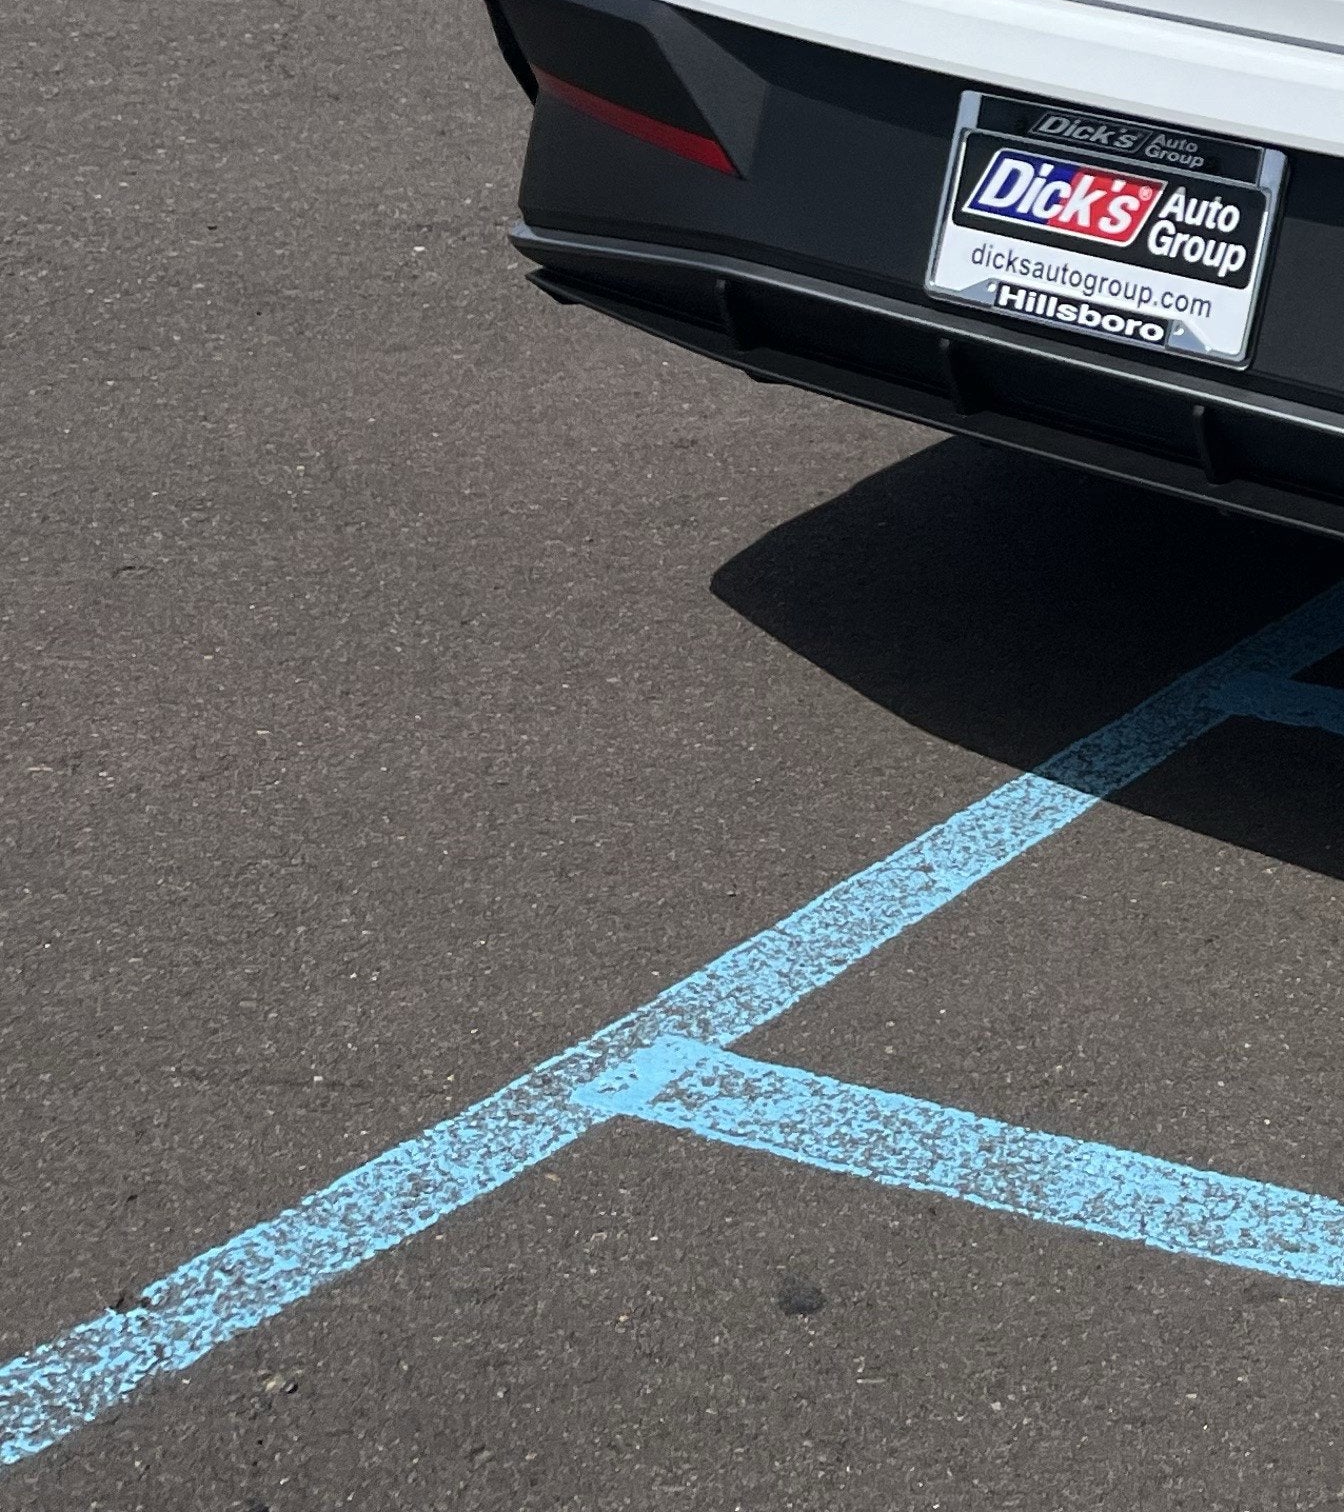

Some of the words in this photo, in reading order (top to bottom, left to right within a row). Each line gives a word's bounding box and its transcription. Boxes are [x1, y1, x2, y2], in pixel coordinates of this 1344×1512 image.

[1038, 115, 1138, 149] Dick's
[1144, 144, 1205, 169] Group
[1152, 133, 1199, 154] Auto
[978, 159, 1141, 236] Dick's
[1159, 186, 1241, 233] Auto
[1147, 220, 1247, 278] Group
[971, 243, 1212, 319] dicksautogroup.com
[997, 285, 1166, 343] Hillsboro
